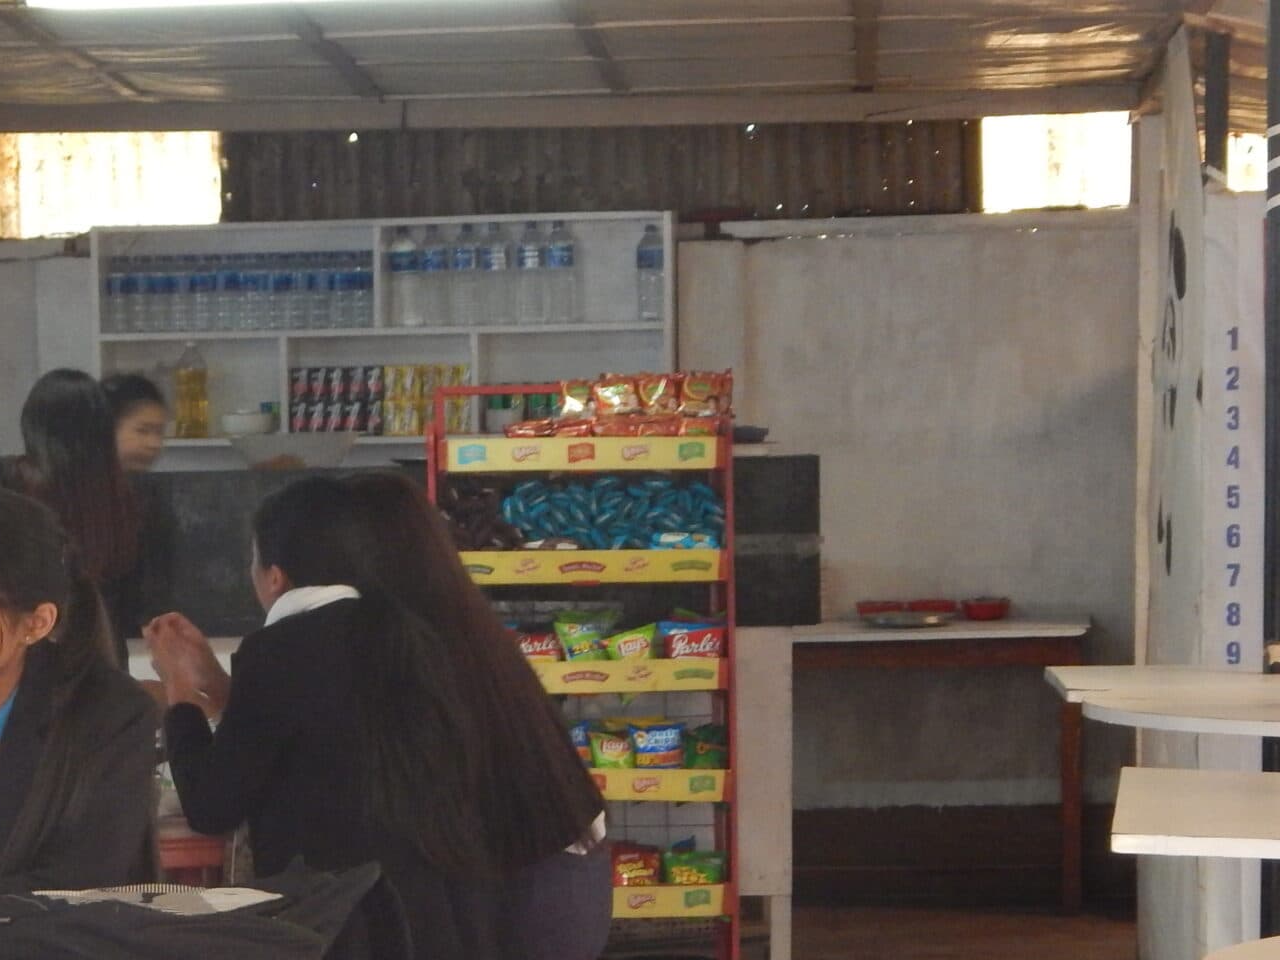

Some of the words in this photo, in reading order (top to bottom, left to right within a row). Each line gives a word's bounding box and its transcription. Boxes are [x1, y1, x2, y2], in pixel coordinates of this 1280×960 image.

[1227, 326, 1239, 351] 1
[1226, 366, 1240, 391] 2
[1226, 406, 1240, 431] 3
[1226, 445, 1240, 469] 4
[1226, 485, 1240, 509] 5
[1226, 524, 1240, 548] 6
[1226, 563, 1241, 587] 7
[1226, 602, 1241, 626] 8
[1226, 641, 1241, 665] 9
